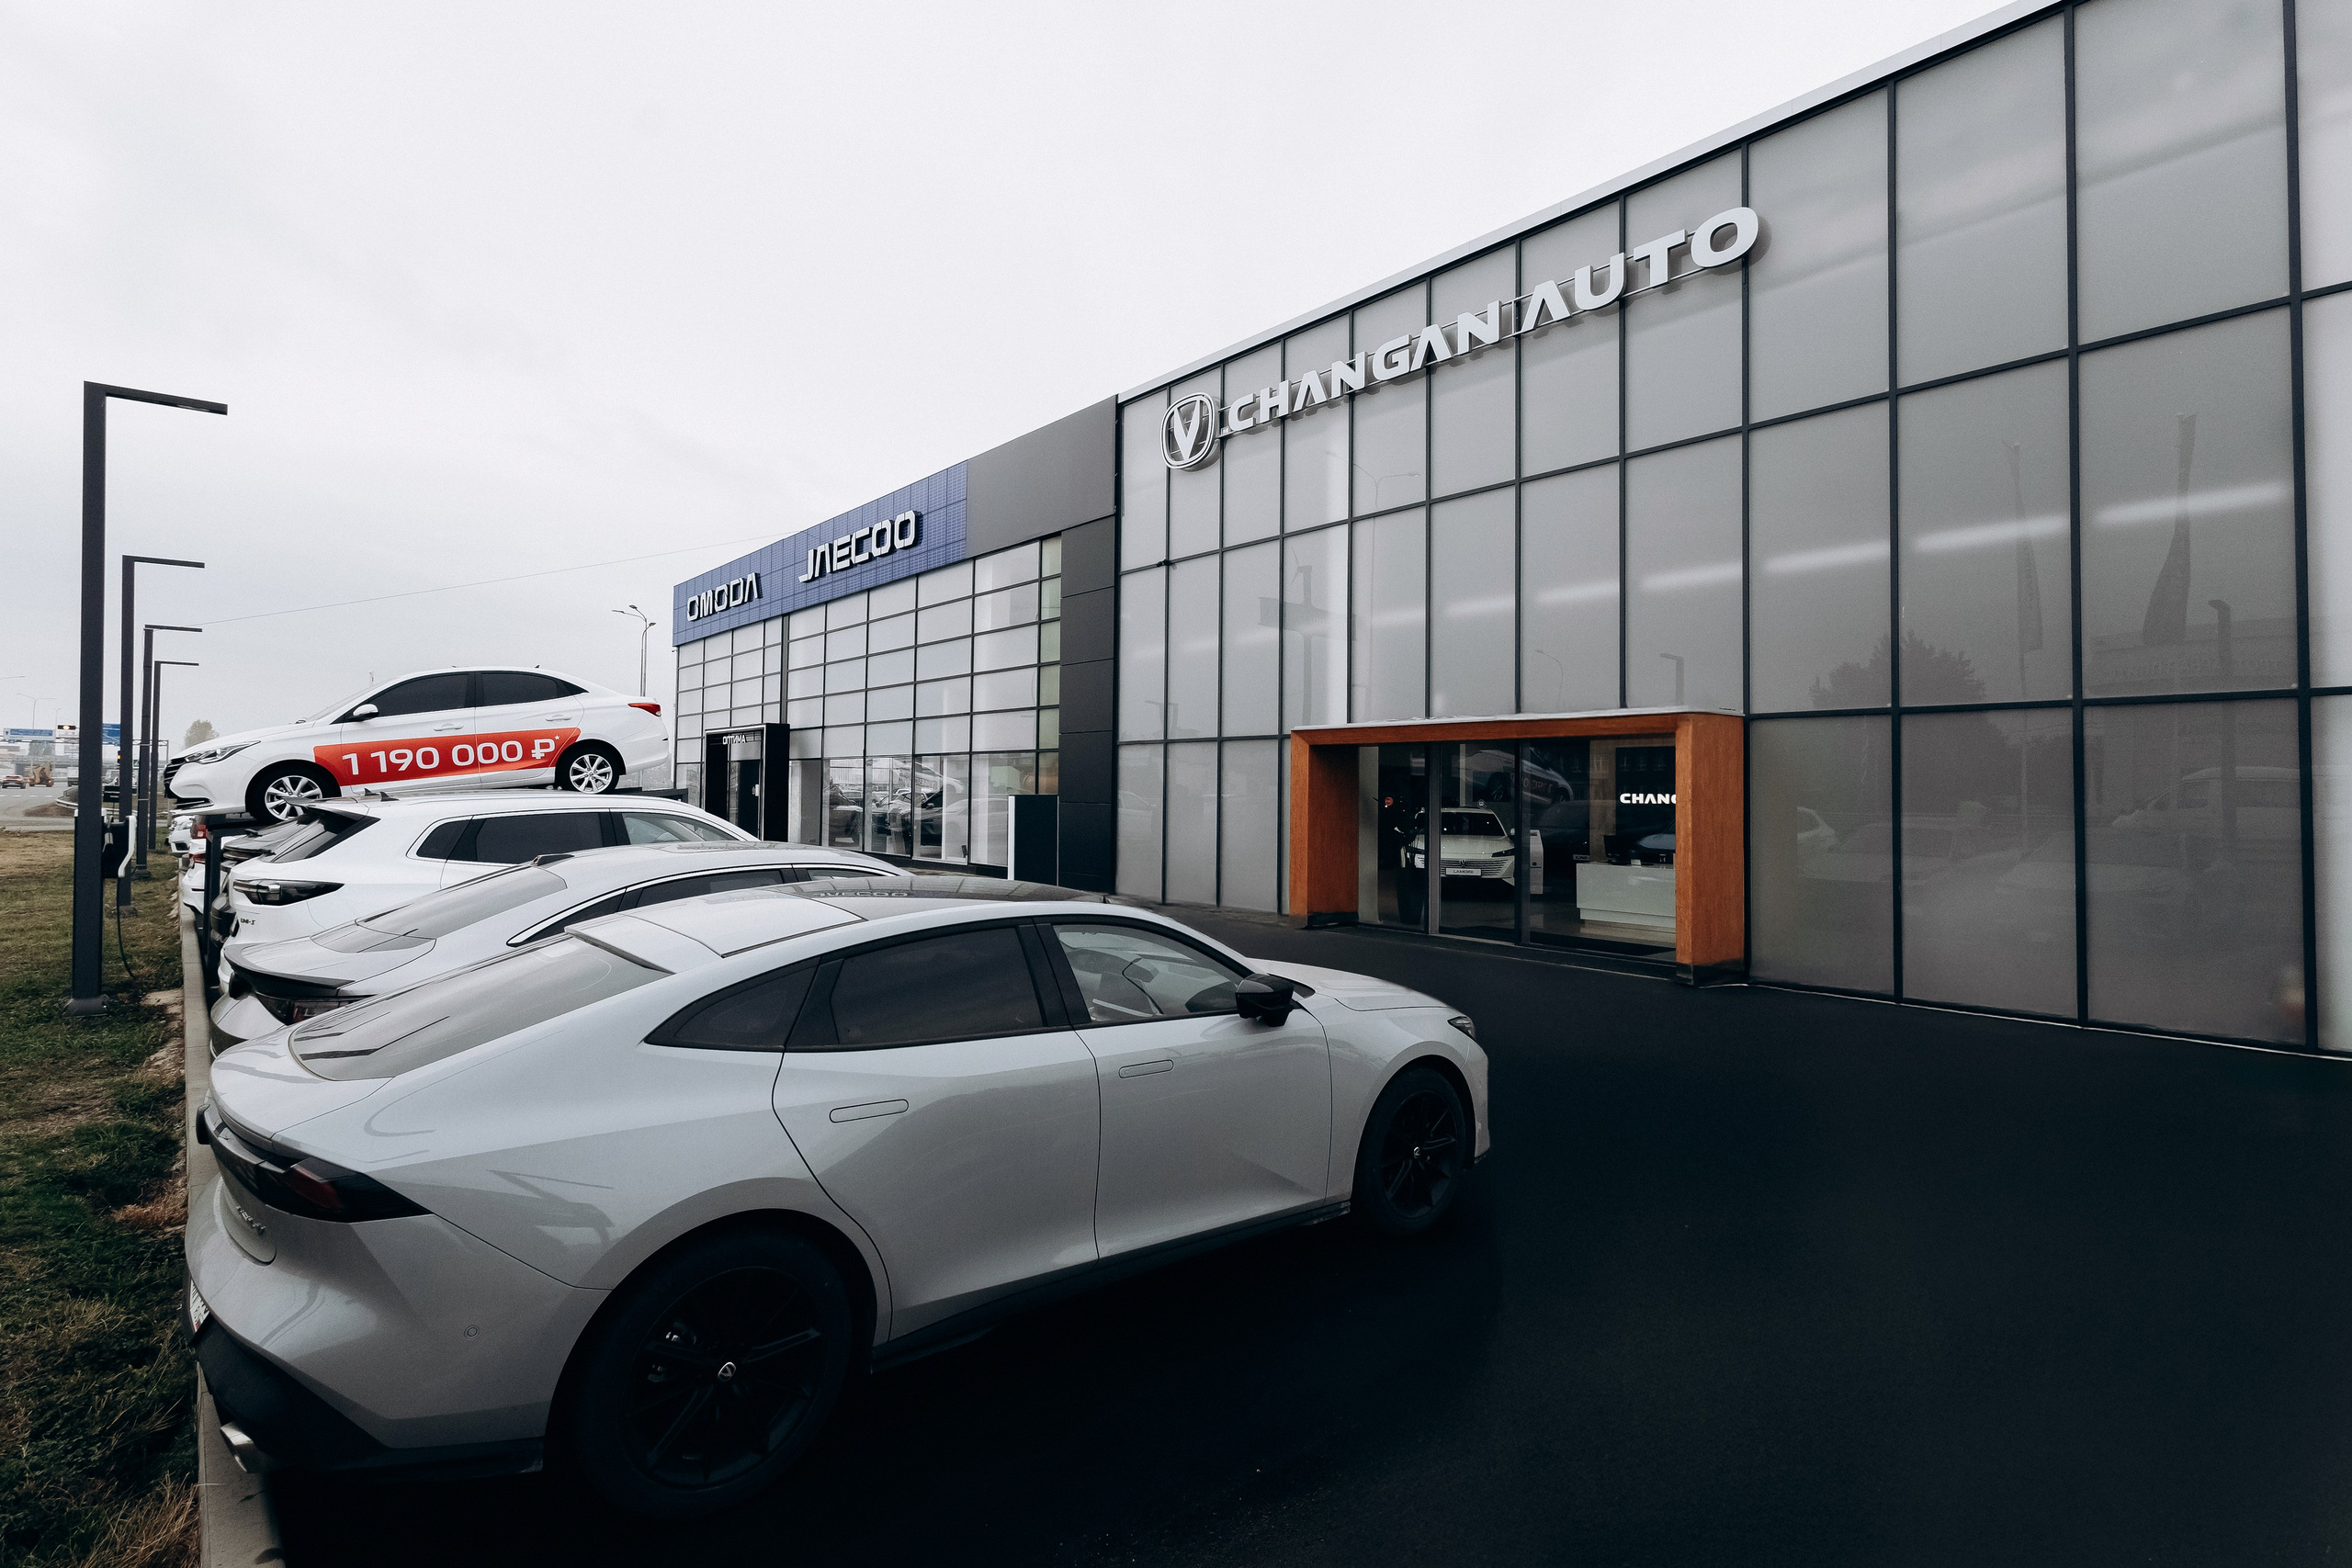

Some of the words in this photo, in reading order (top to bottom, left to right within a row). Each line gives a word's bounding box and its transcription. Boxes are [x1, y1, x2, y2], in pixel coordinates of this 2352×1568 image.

[1228, 300, 1502, 432] CHANGAN
[1521, 207, 1759, 332] AUTO
[687, 571, 760, 622] OMODA
[798, 510, 917, 583] JAECOO
[370, 747, 440, 773] 190
[452, 740, 524, 767] 000
